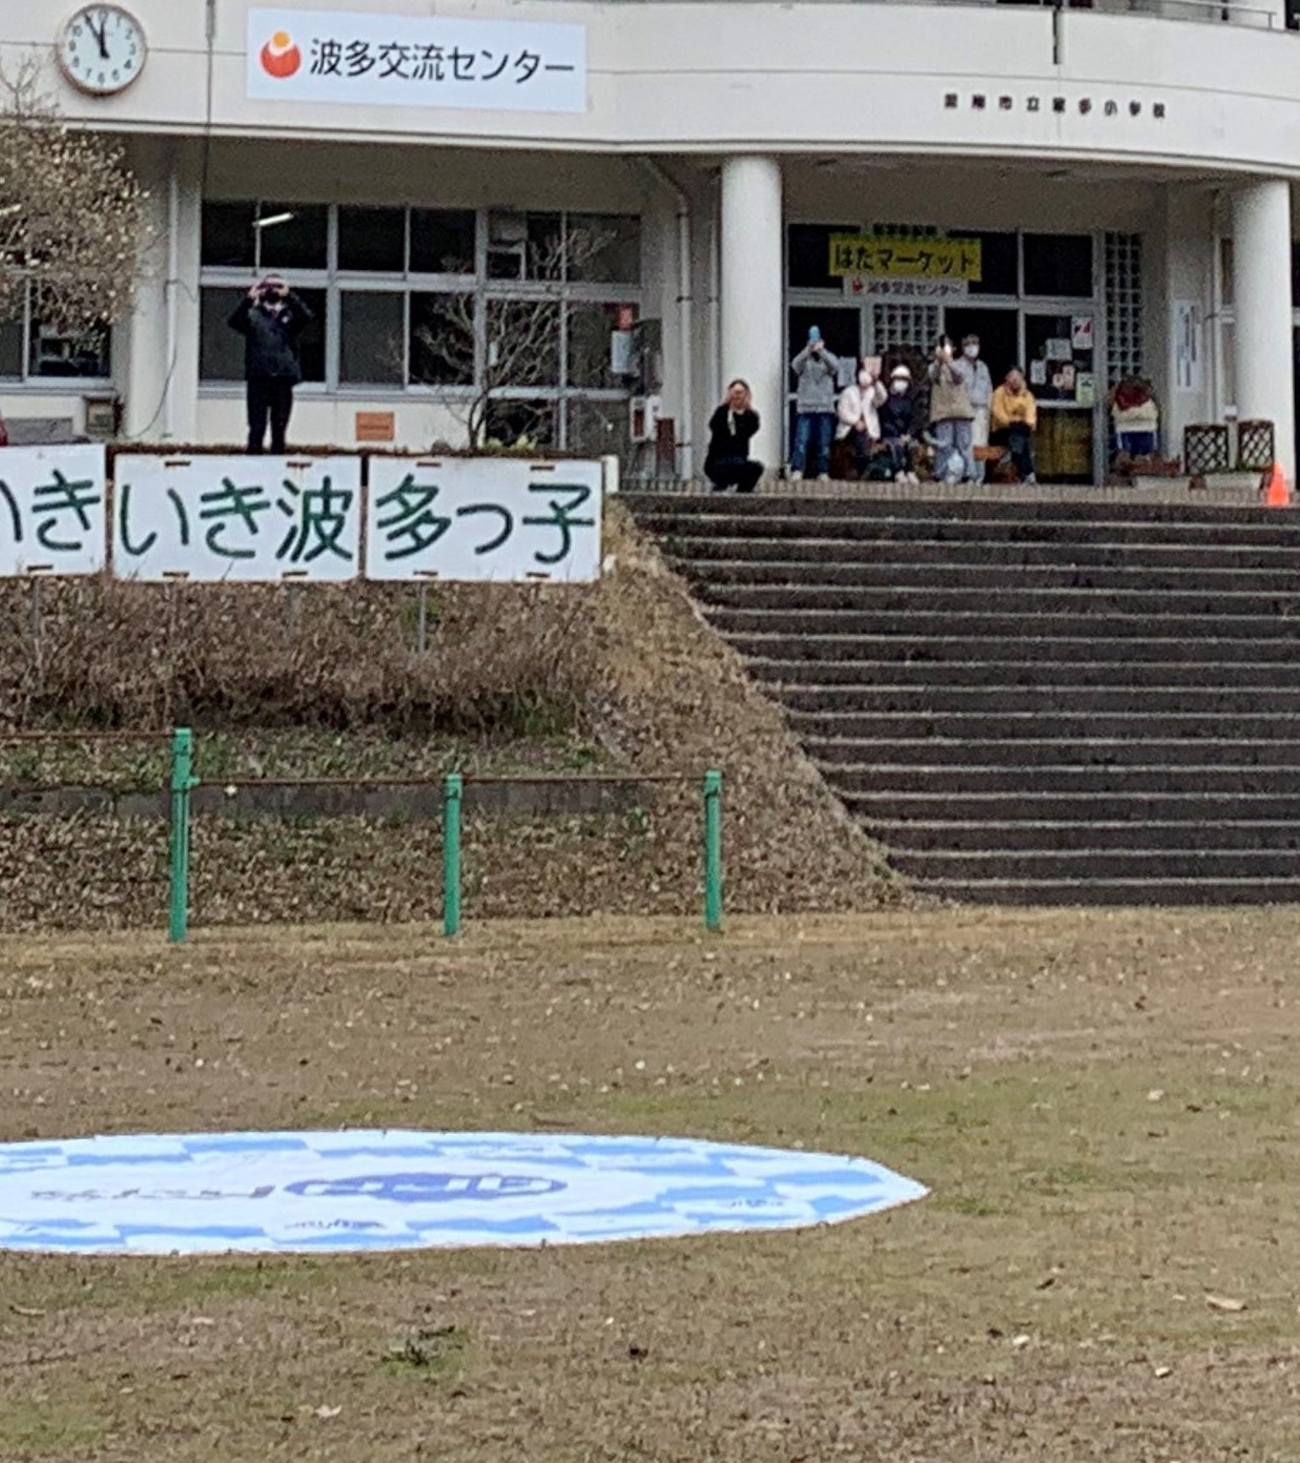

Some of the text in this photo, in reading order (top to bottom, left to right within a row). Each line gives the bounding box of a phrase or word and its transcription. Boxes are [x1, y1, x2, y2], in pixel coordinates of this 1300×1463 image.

[309, 38, 576, 84] 波多交流センター
[834, 244, 974, 274] はたマーケット
